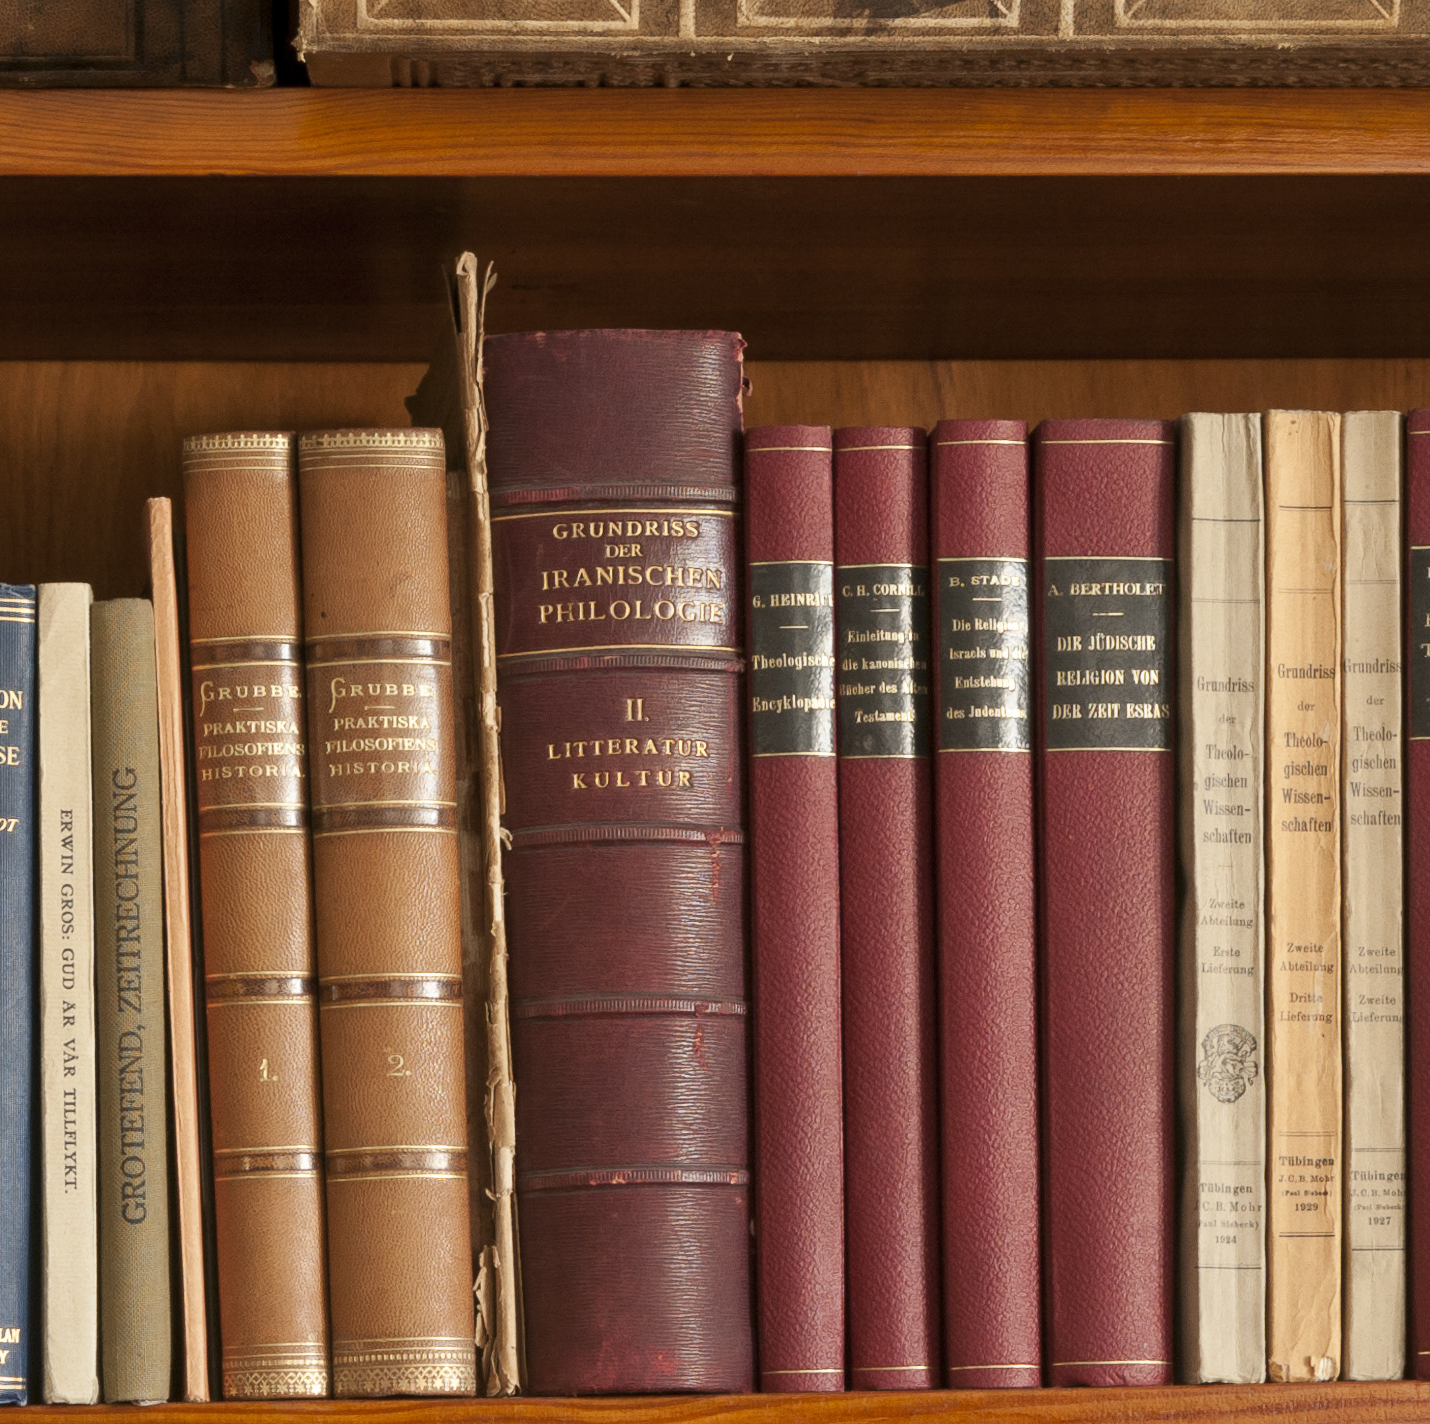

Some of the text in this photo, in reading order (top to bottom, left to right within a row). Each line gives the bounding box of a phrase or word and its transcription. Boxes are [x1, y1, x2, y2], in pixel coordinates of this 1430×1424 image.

[553, 521, 700, 540] GRUNDRISS
[605, 543, 643, 558] DER
[541, 566, 722, 590] IRANISCHEN
[1071, 582, 1165, 596] BERTHOLET
[539, 600, 726, 624] PHILOLOGIE
[1057, 632, 1155, 652] DIE JÜDISCHE
[752, 655, 835, 670] Theologische
[1057, 670, 1159, 686] RELIGION VON
[1277, 664, 1335, 679] Grundriss
[1051, 703, 1170, 720] DER ZEIT ESRAS
[203, 720, 299, 736] PRAKTISKA
[333, 715, 431, 731] PRAKTISKA
[199, 742, 305, 758] FILOSOFIENS
[326, 738, 436, 753] FILOSOFIENS
[548, 740, 710, 760] LITTERATUR
[1283, 761, 1328, 778] gischen
[572, 770, 693, 789] KULTUR
[1281, 789, 1330, 805] Wissen-
[1281, 818, 1332, 833] schaften
[60, 808, 79, 1194] ERWIN GROS: GUD TILLFLYKT.
[112, 767, 148, 1225] GROTEFEND, ZEITRECHNUNG
